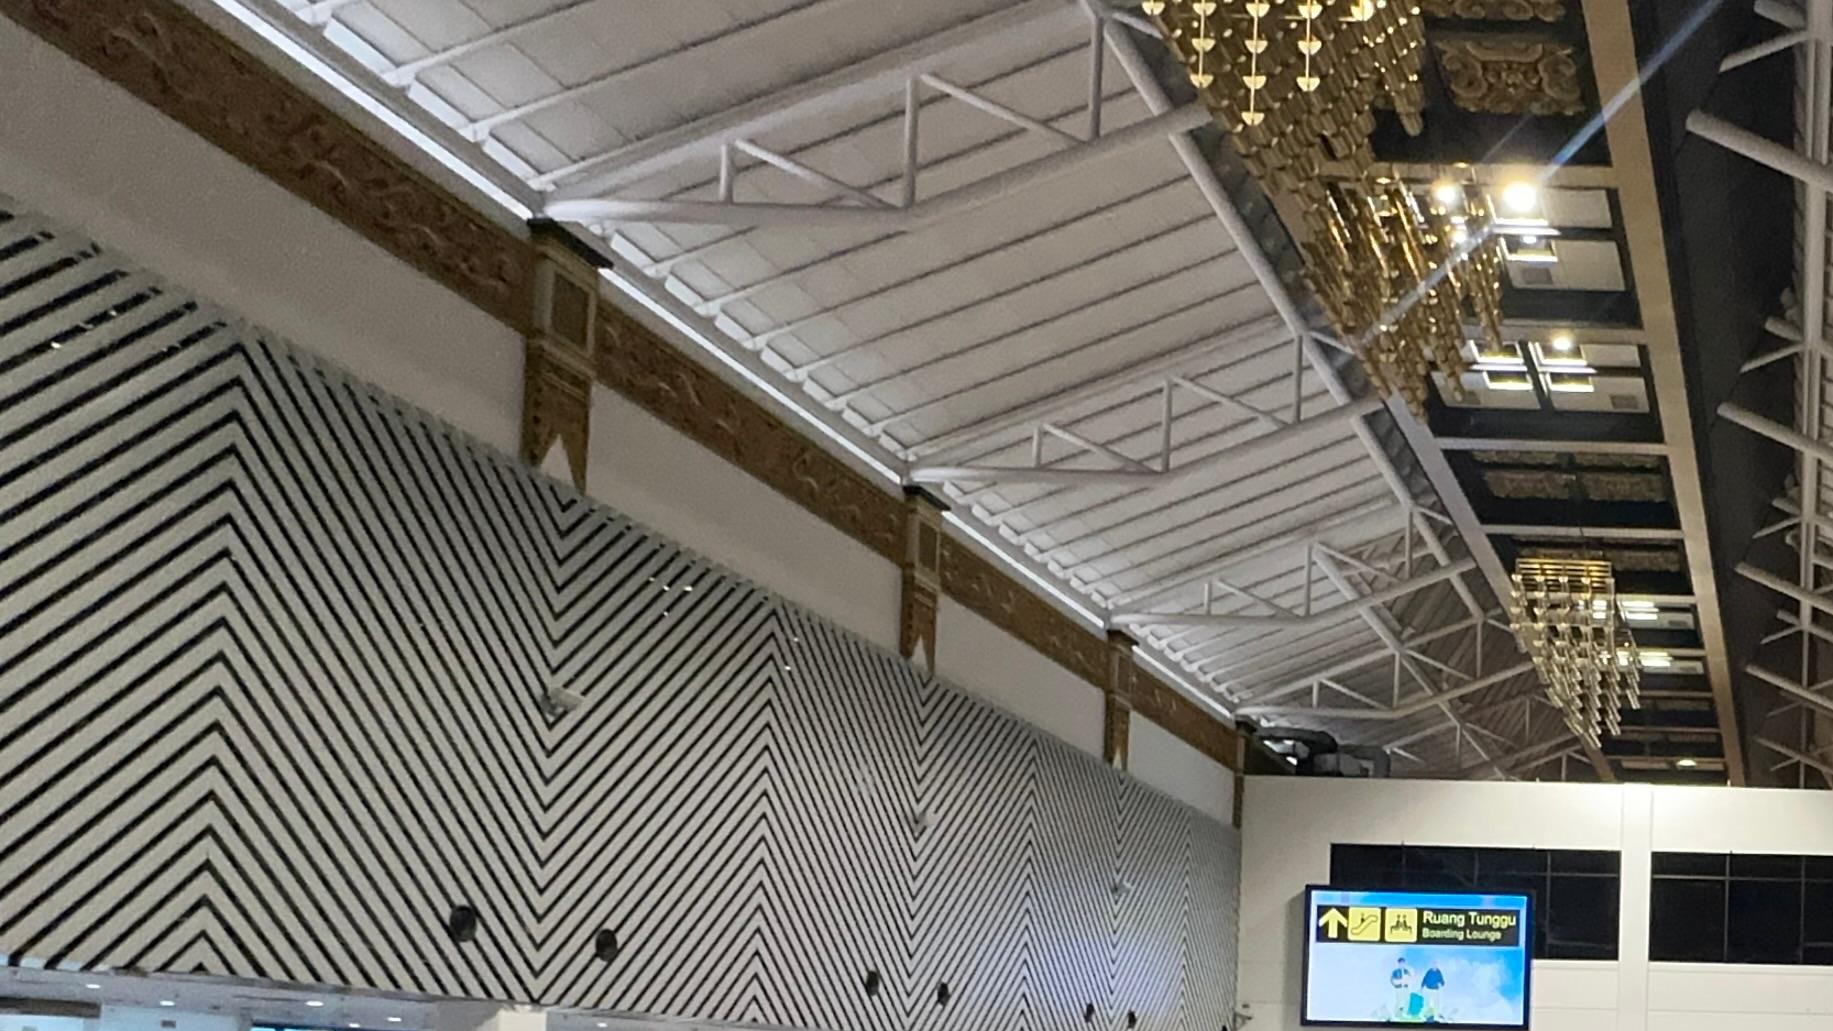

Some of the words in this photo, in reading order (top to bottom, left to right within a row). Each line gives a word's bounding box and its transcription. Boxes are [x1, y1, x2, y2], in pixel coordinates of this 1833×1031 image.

[1423, 911, 1465, 927] Ruang
[1468, 912, 1516, 928] Tunggu
[1422, 928, 1464, 941] Boarding
[1466, 929, 1501, 942] Lounge
